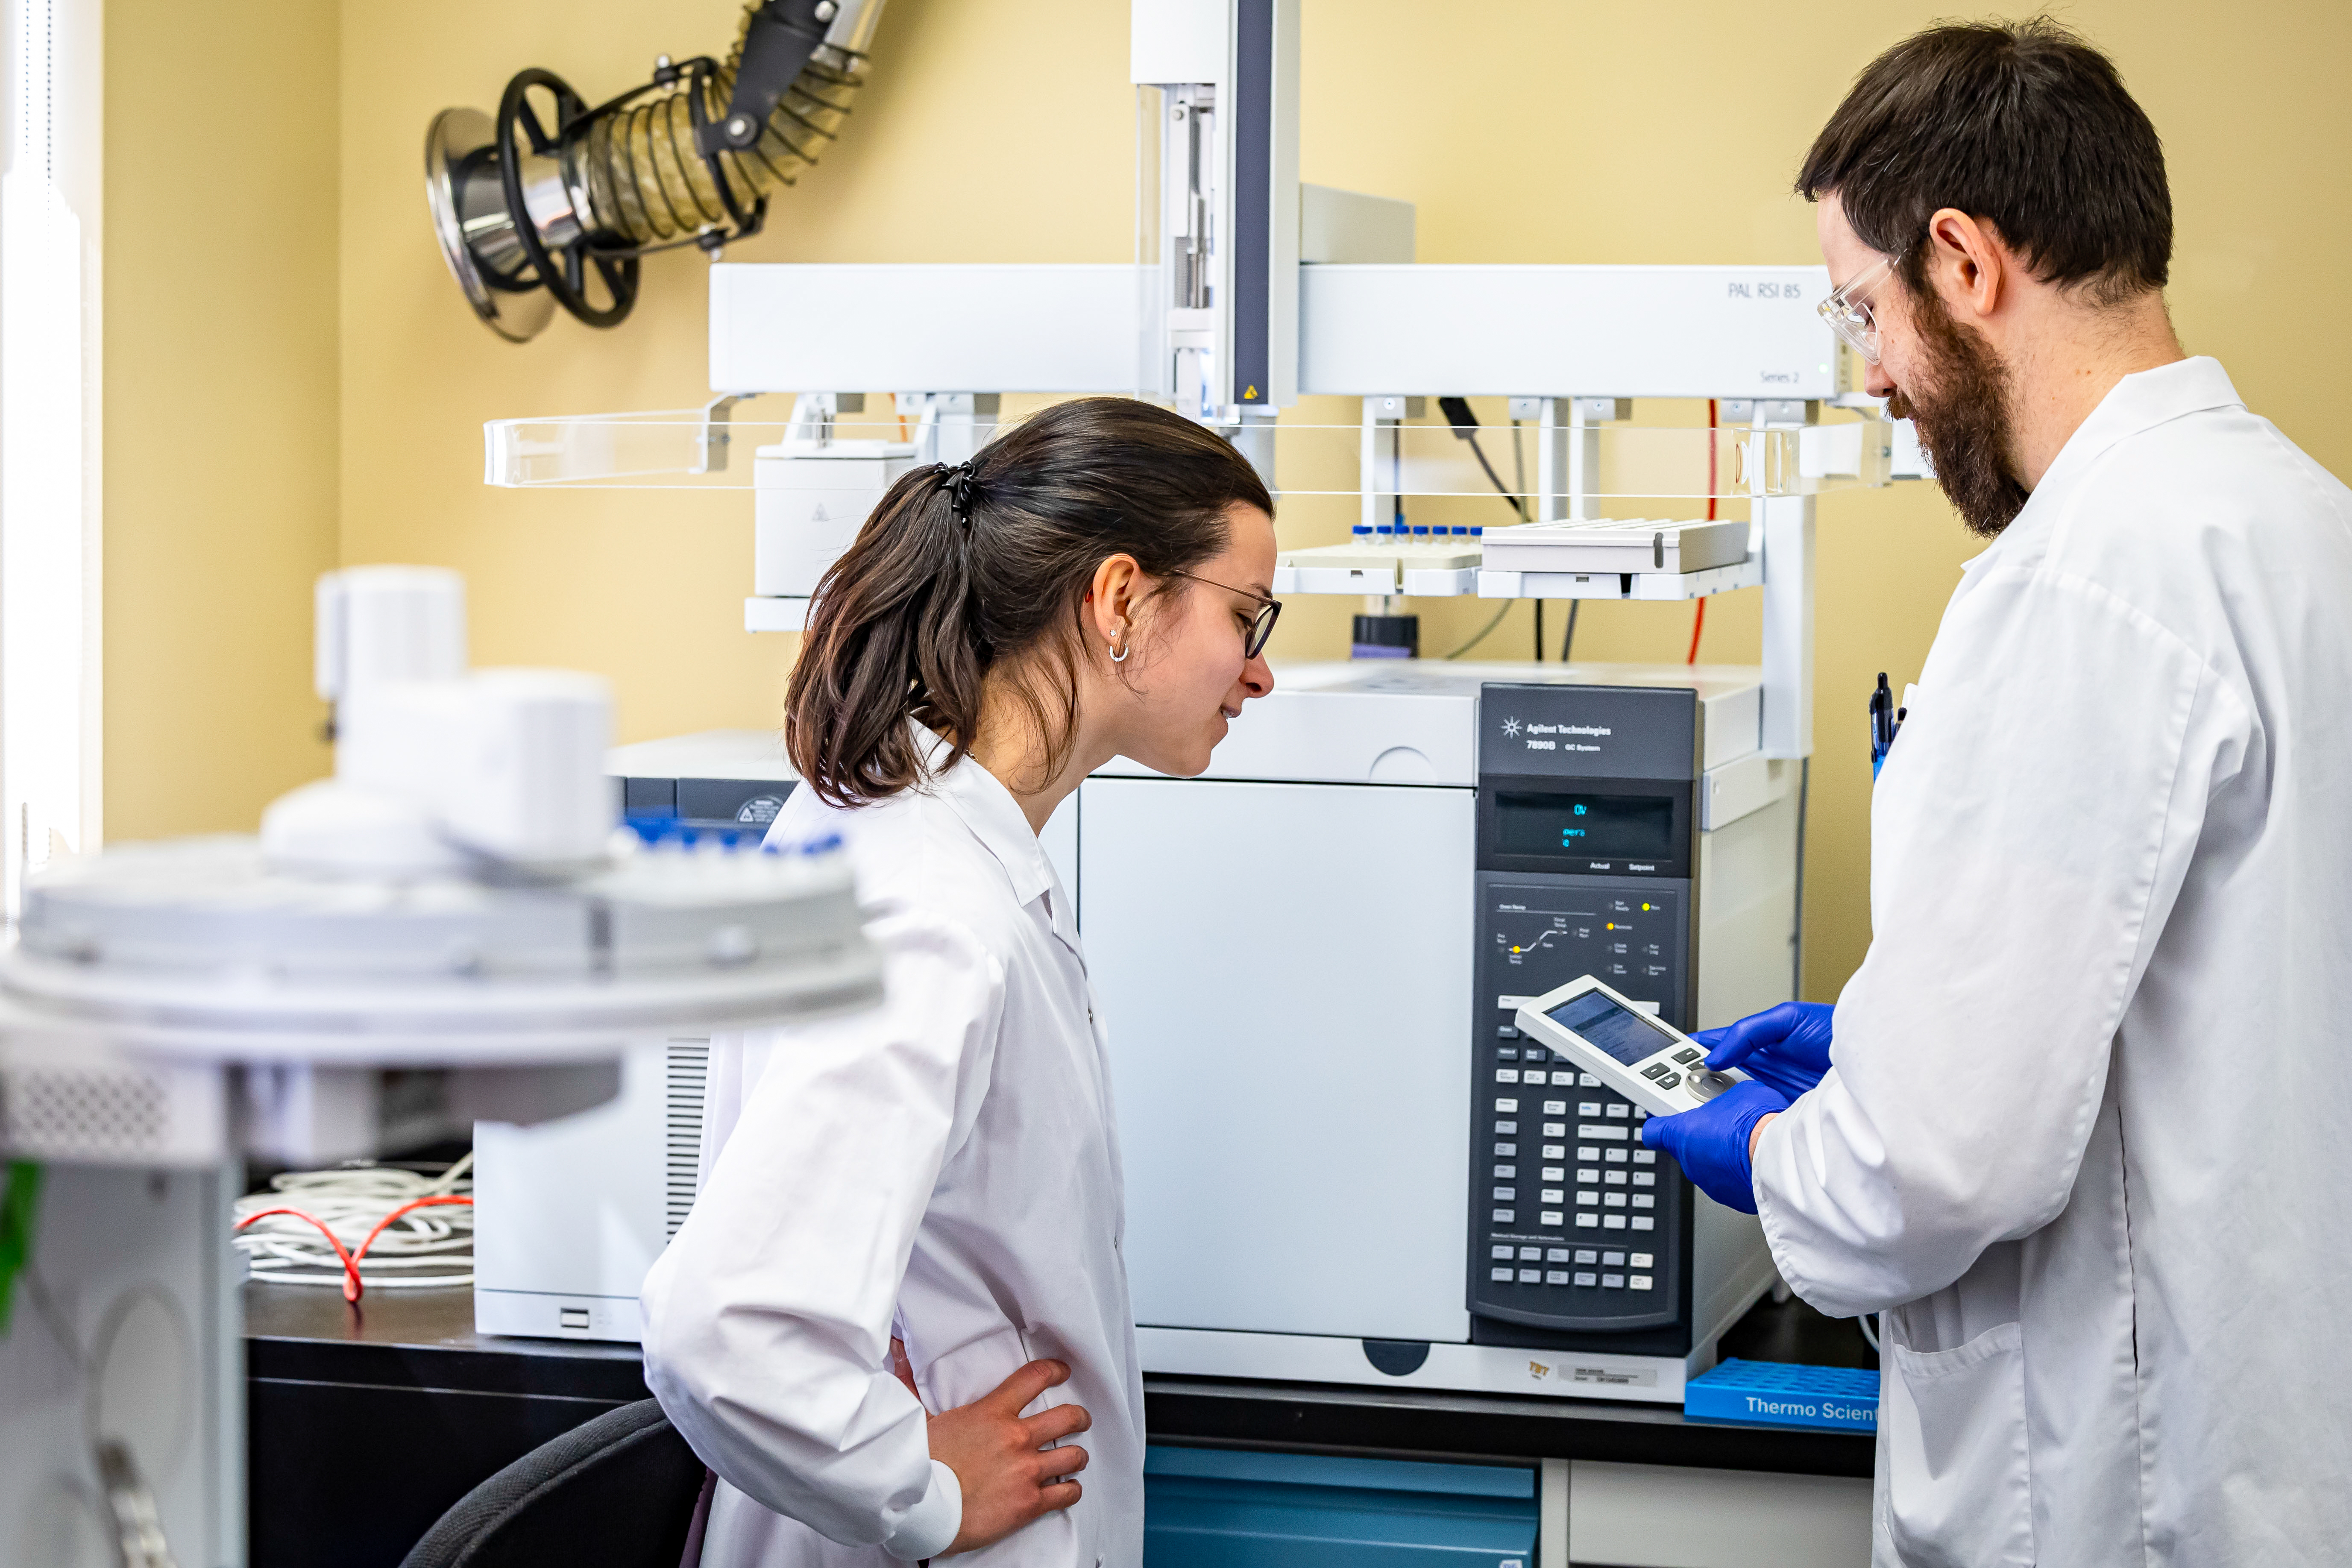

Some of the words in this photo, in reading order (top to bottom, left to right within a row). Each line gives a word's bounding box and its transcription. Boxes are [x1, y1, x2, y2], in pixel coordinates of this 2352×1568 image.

[1728, 282, 1752, 298] PAL
[1758, 282, 1779, 298] RSI
[1783, 283, 1801, 299] 85
[1760, 371, 1790, 383] Series
[1793, 372, 1799, 383] 2
[1527, 724, 1557, 735] Agilent
[1558, 724, 1611, 737] Technologies
[1526, 740, 1556, 750] 7890B
[1628, 863, 1655, 871] Setpoint
[1746, 1396, 1816, 1417] Thermo
